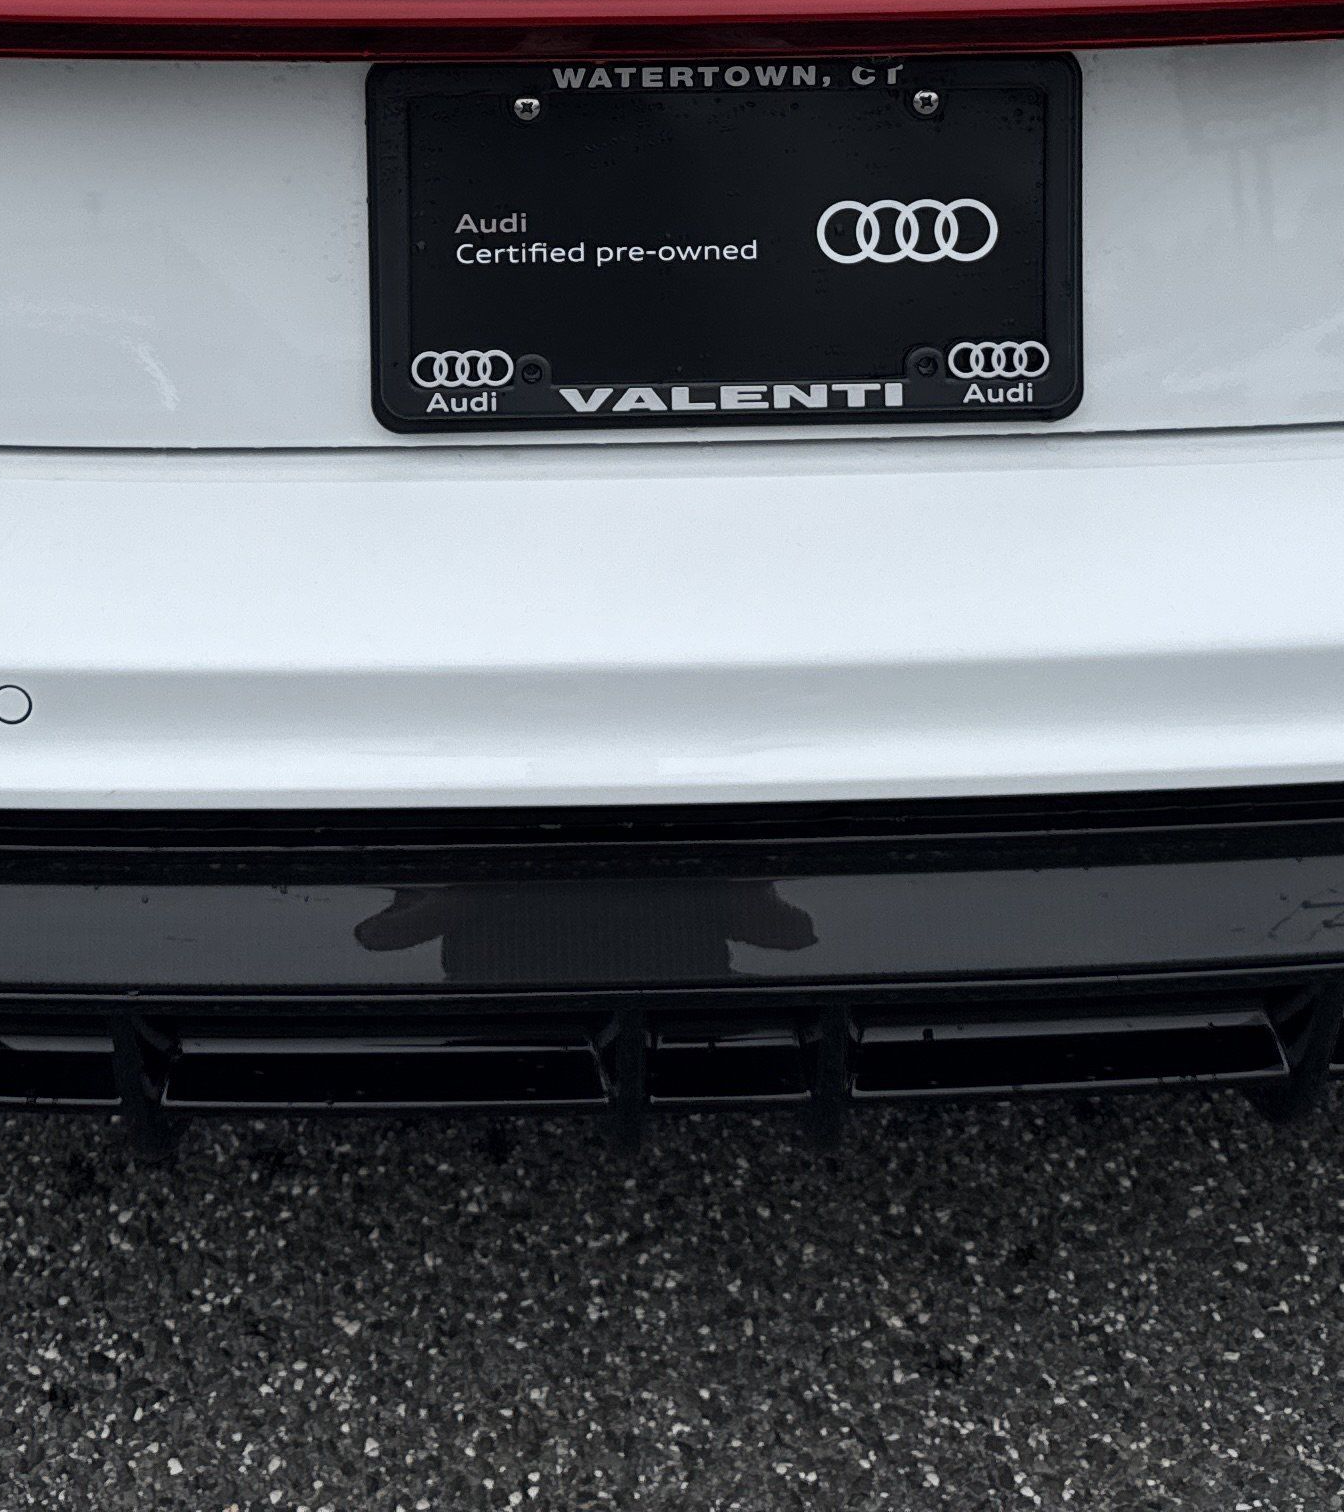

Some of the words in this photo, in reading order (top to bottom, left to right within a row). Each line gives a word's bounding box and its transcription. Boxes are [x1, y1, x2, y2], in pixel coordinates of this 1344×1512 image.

[552, 65, 832, 89] WATERTOWN,
[455, 212, 527, 234] Audi
[456, 241, 585, 264] Certified
[596, 239, 757, 267] pre-owned
[426, 391, 498, 413] Audi
[559, 382, 904, 413] VALENTI
[962, 382, 1034, 404] Audi
